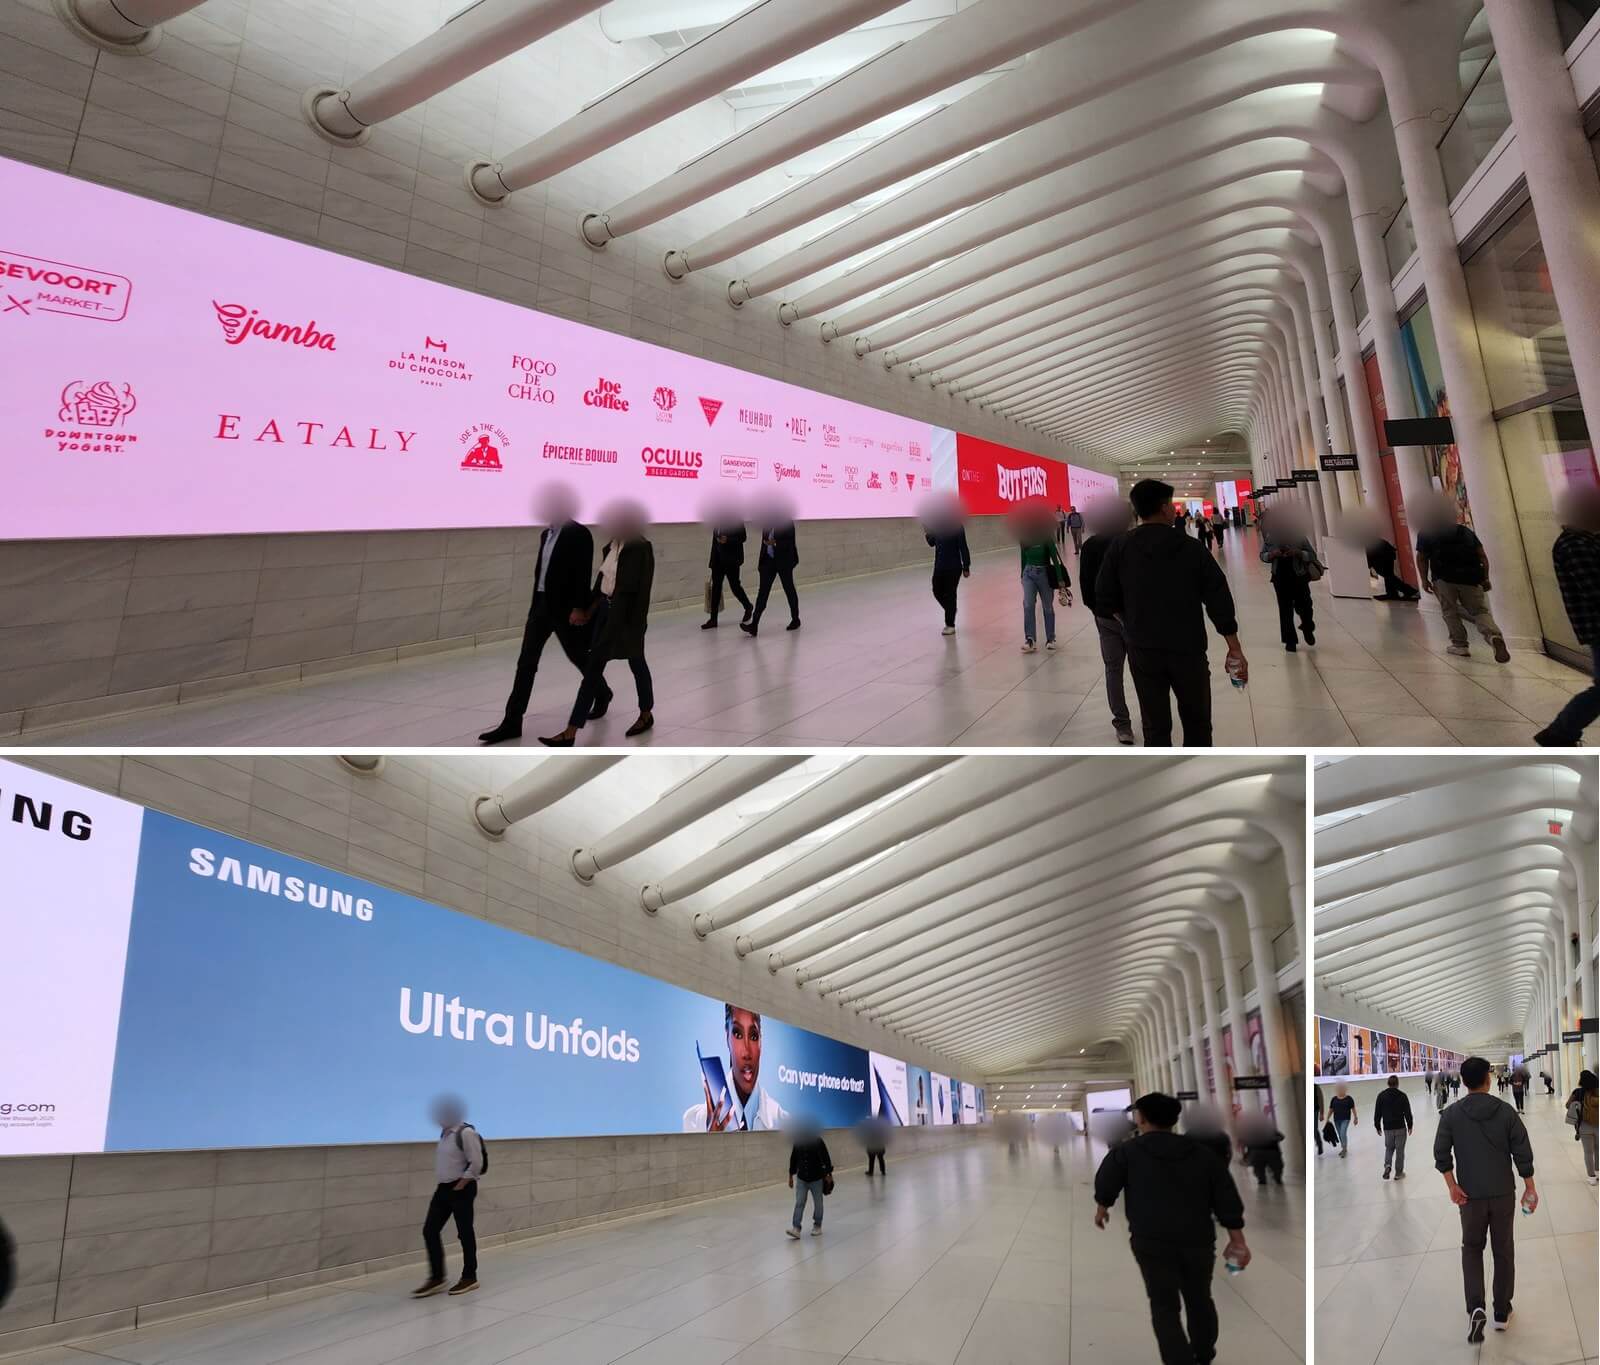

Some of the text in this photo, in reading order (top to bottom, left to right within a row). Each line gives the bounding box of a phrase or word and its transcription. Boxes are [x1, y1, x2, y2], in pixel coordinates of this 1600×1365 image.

[37, 292, 103, 311] MARKET
[225, 309, 336, 351] jamba
[389, 360, 473, 381] DU CHOCOLAT
[401, 352, 465, 370] LA MAISON
[512, 355, 557, 376] FOGO
[525, 373, 541, 386] DE
[597, 377, 622, 395] Joe
[583, 390, 630, 412] Coffee
[739, 408, 773, 428] NEUHAUS
[791, 417, 807, 437] PRET
[44, 429, 137, 443] DOWNTOWN
[214, 414, 417, 452] EATALY
[459, 423, 511, 447] JOE & THE JUICE
[543, 442, 618, 464] ÉPICERIE BOULUD
[641, 447, 703, 468] OCULUS
[997, 463, 1048, 501] BUT FIRST
[188, 847, 374, 922] SAMSUNG
[399, 986, 640, 1064] Ultra Unfolds
[778, 1065, 865, 1093] Can your phone do that?
